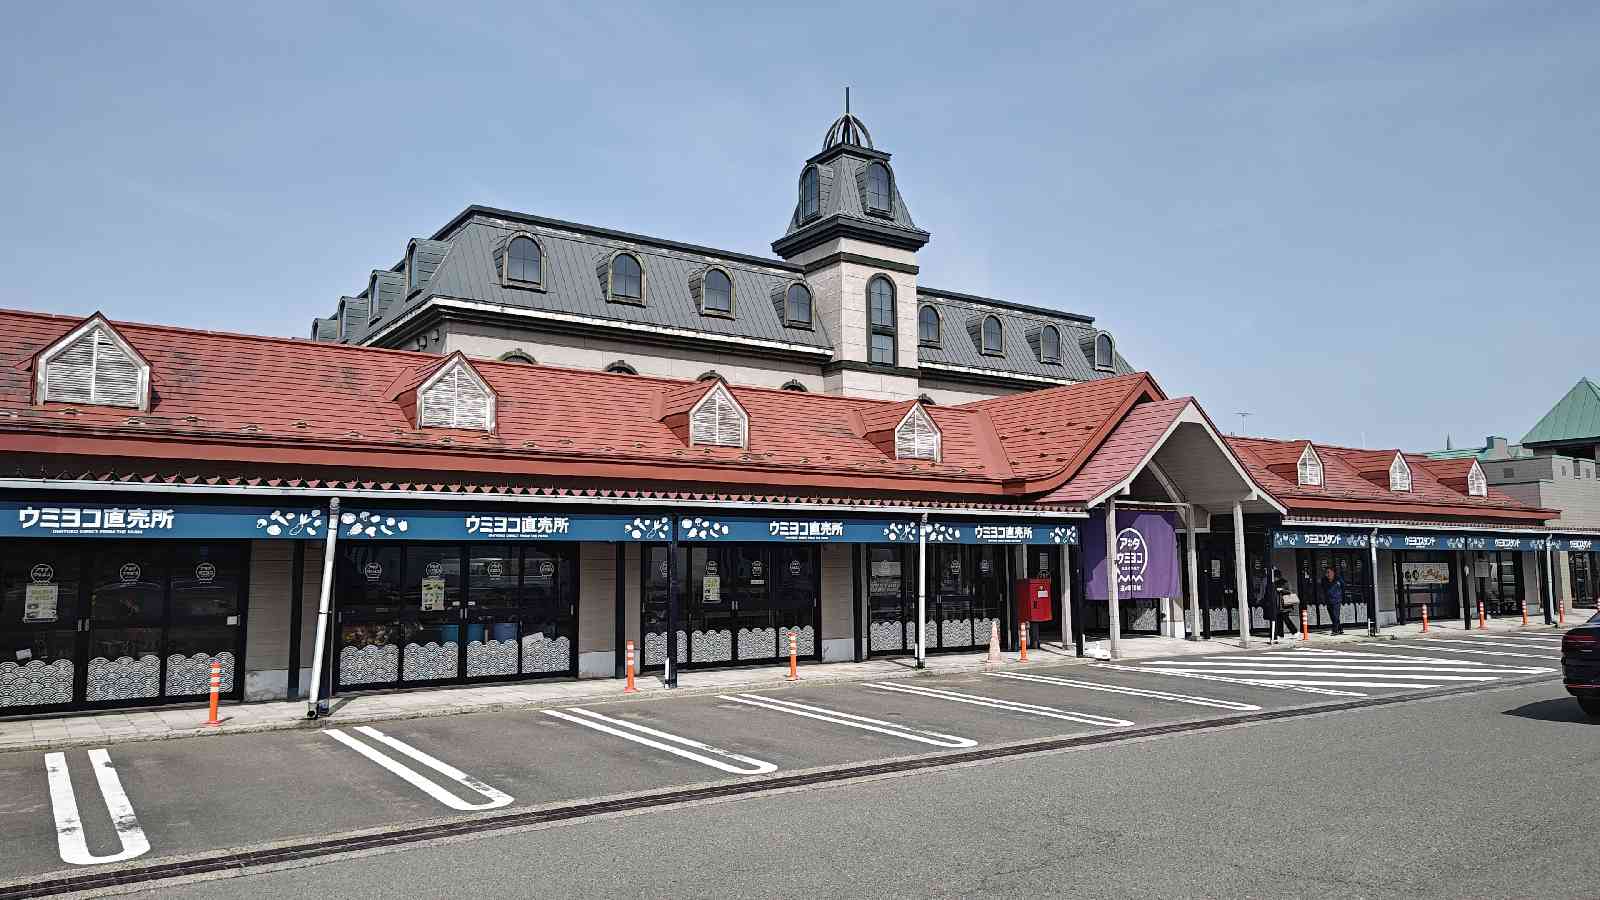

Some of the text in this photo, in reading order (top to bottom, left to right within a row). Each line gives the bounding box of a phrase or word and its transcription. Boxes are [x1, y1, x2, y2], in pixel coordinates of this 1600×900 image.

[19, 506, 175, 529] ウミヨコ直売所
[465, 515, 570, 534] ウミヨコ直売所
[769, 521, 844, 536] ウミヨコ直売所
[975, 525, 1033, 539] ウミヨコ直売所
[1117, 551, 1142, 564] ウミヨコ
